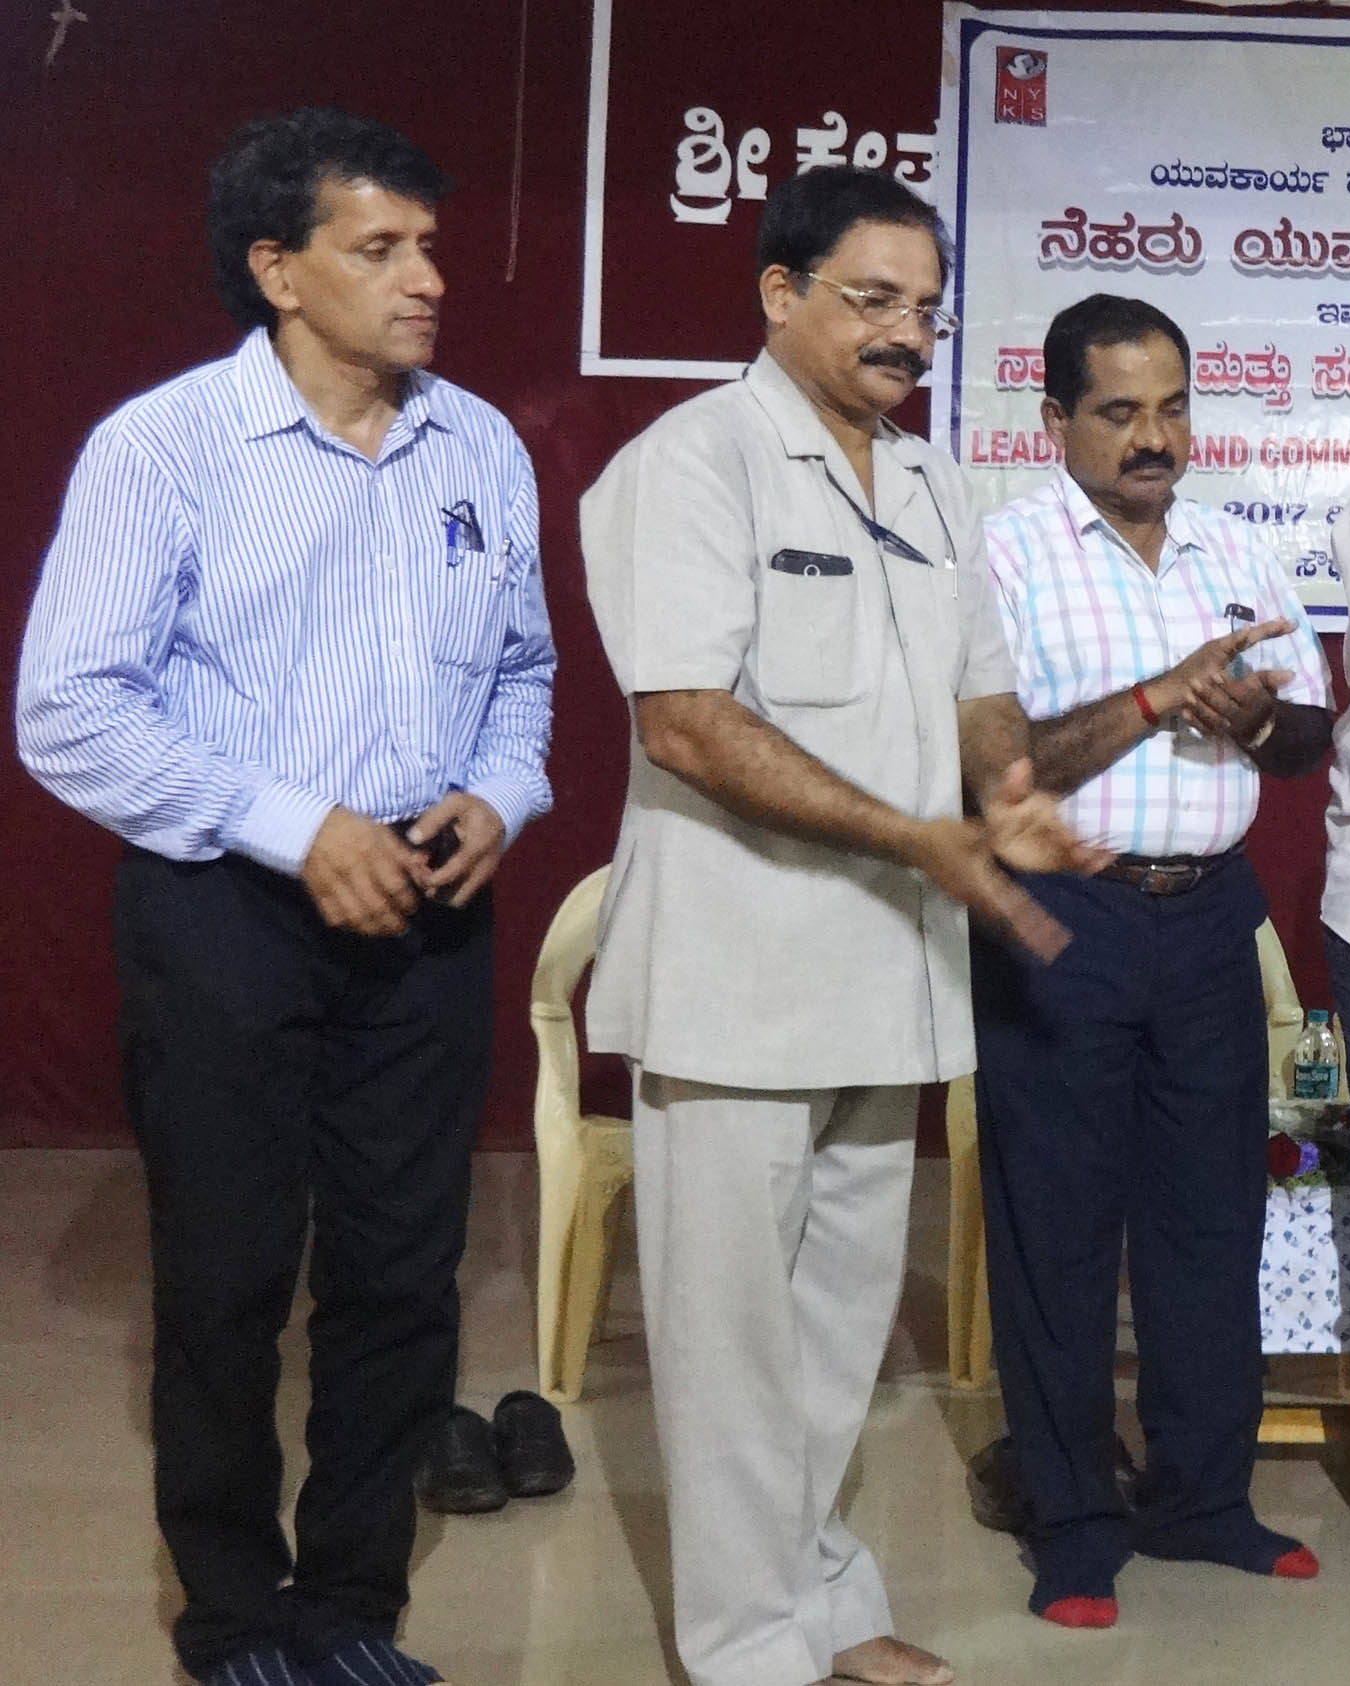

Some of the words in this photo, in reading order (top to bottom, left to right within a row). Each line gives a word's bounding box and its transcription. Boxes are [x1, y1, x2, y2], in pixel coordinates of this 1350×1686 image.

[670, 106, 771, 225] ಶ್ರೀ
[1150, 159, 1330, 194] ಯುವಕಾರ್ಯ
[1040, 206, 1204, 266] ನೆಹರು
[1195, 340, 1293, 408] ಮತ್ತು
[1188, 436, 1251, 470] AND
[1223, 500, 1309, 527] 2017
